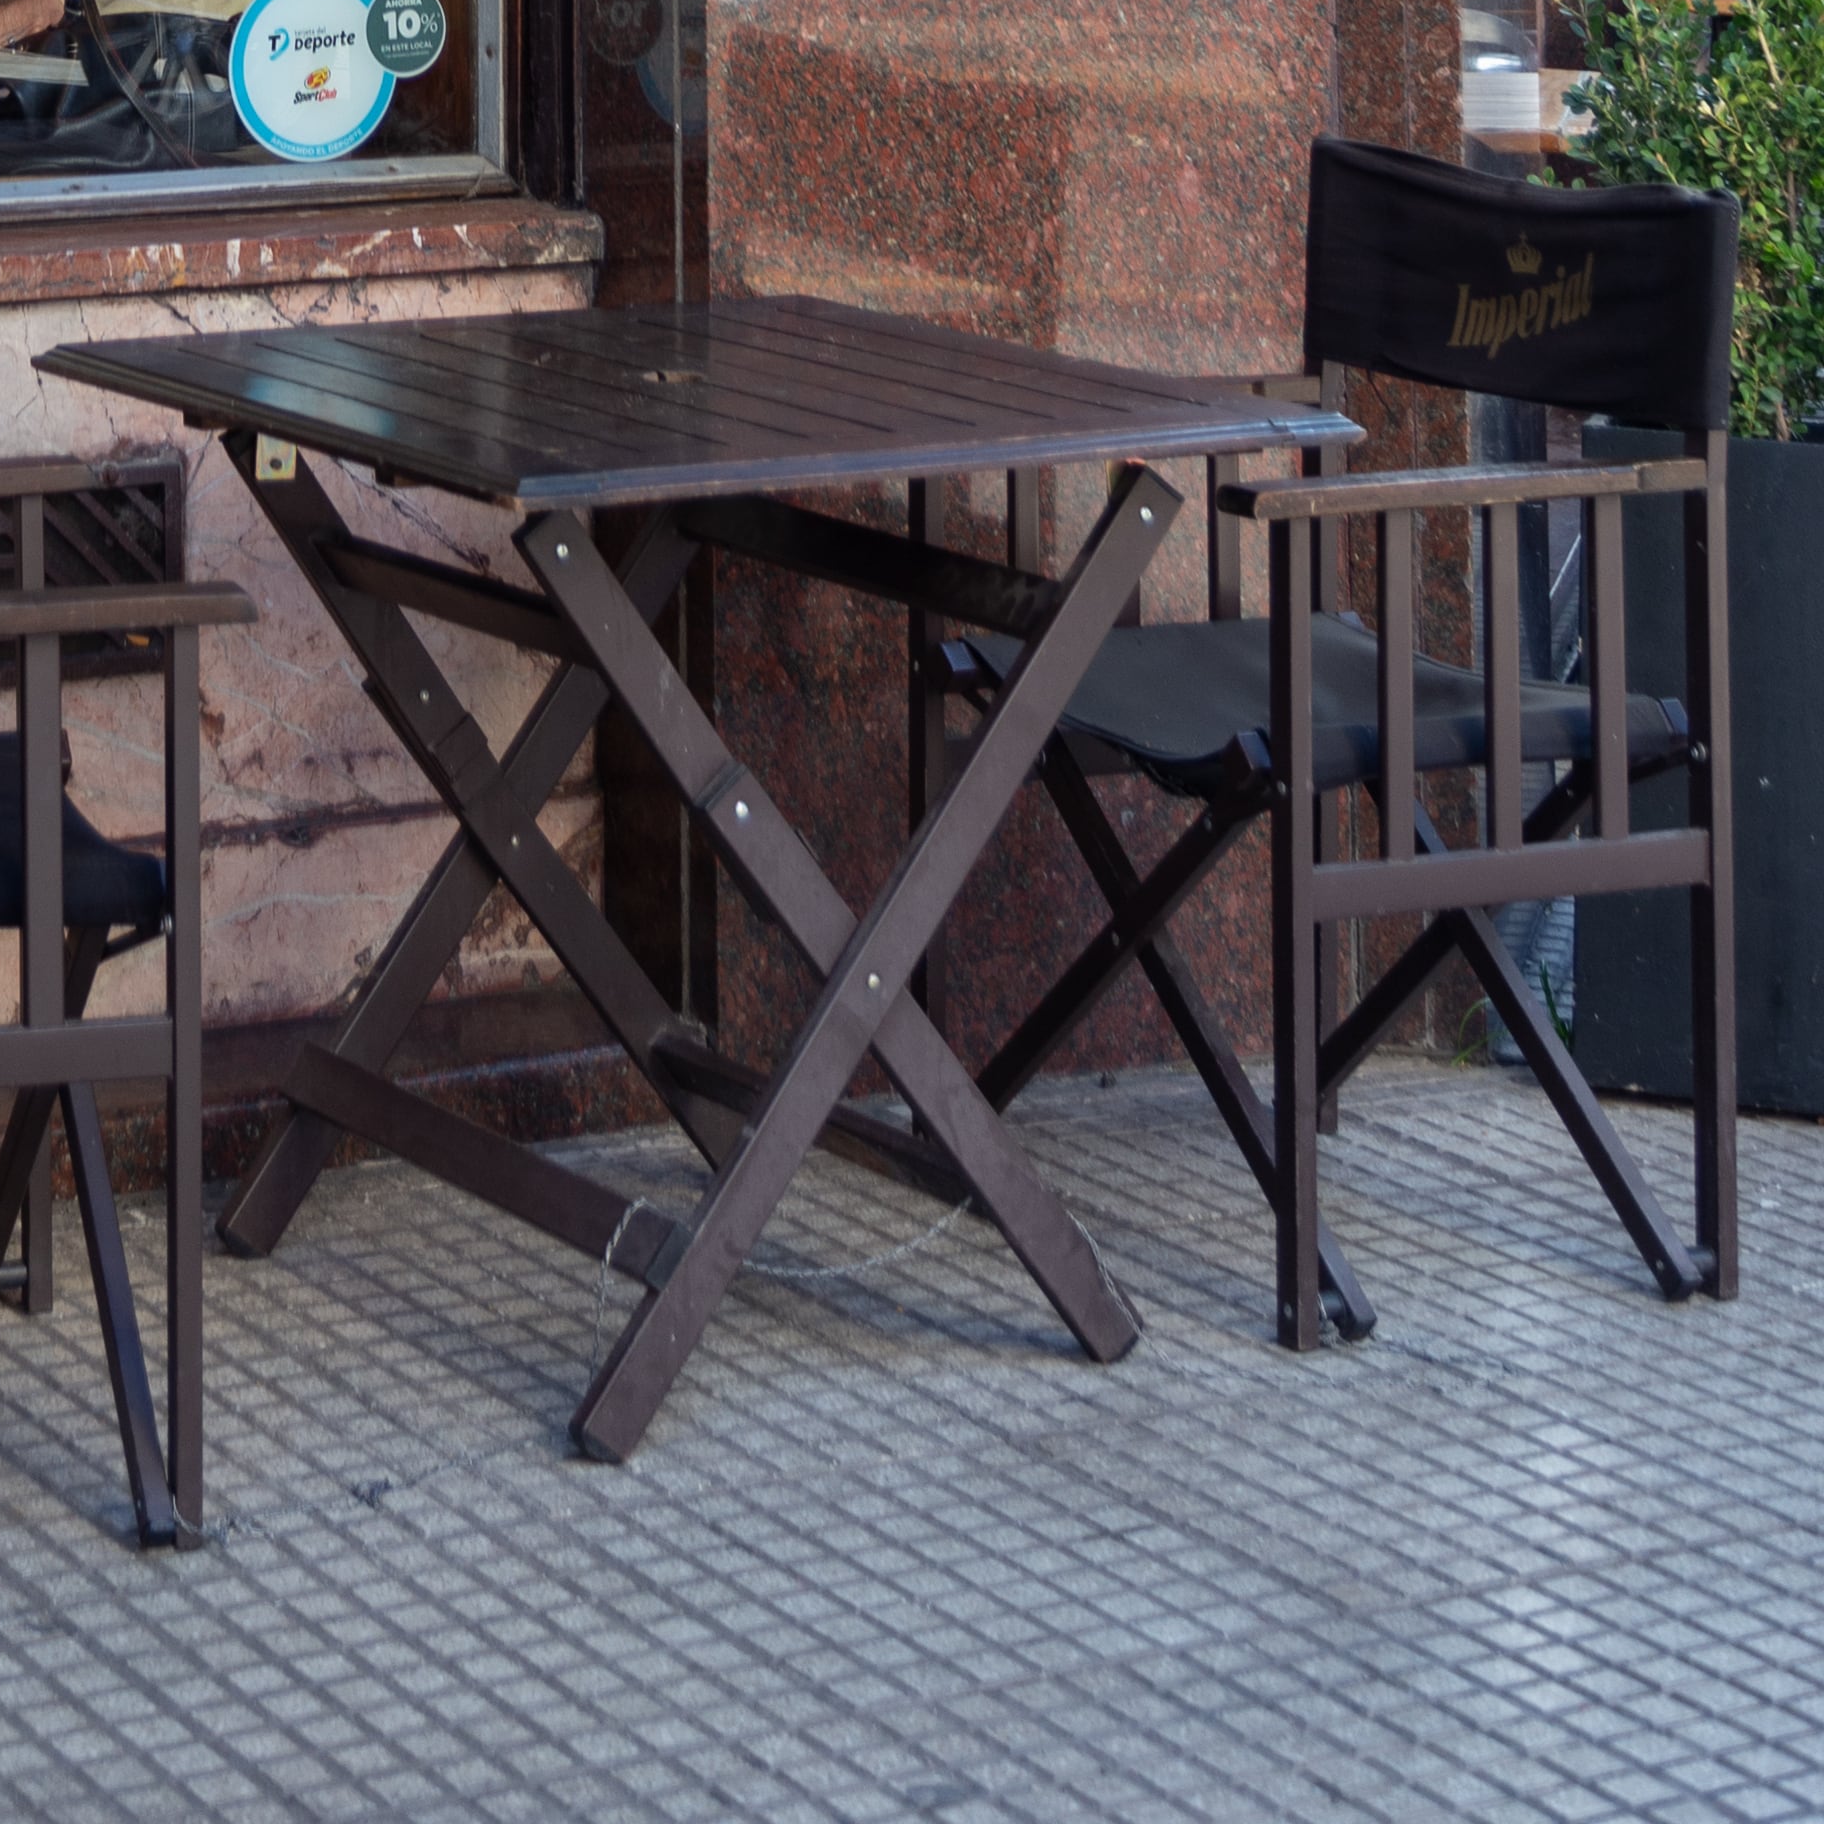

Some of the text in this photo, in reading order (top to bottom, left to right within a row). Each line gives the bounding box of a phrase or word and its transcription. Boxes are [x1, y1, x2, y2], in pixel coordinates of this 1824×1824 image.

[392, 42, 409, 52] ESTE
[410, 39, 433, 50] LOCAL
[1446, 252, 1594, 360] Imperial
